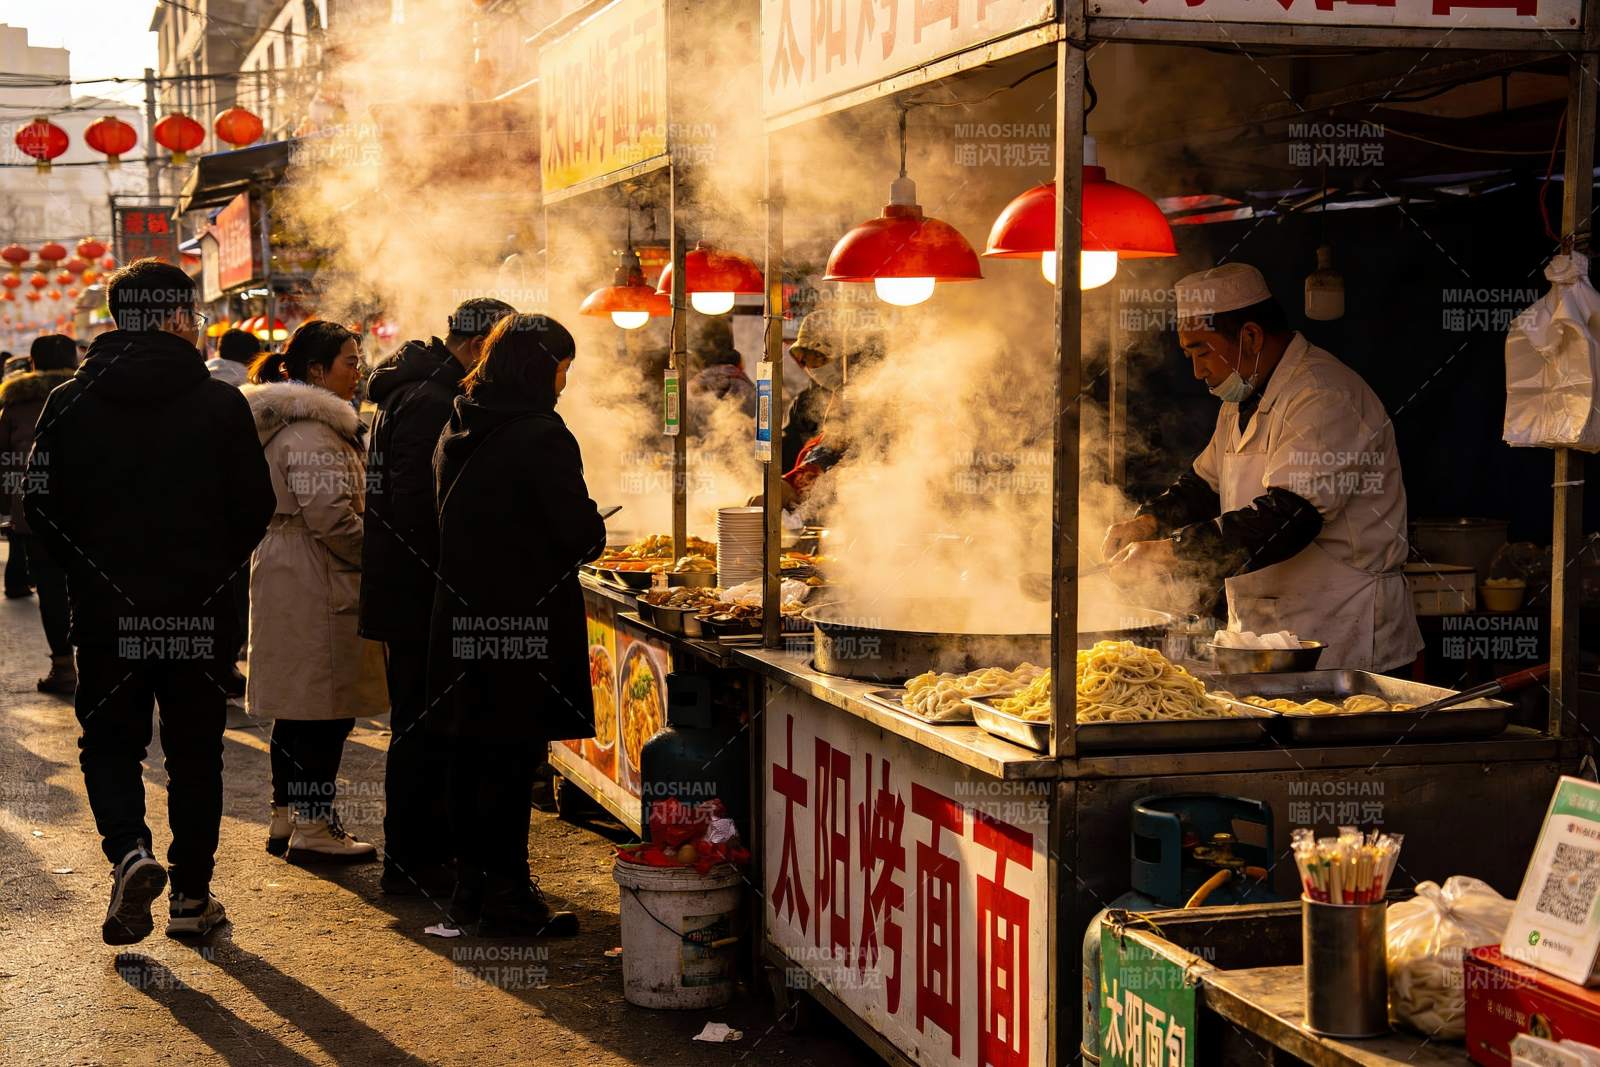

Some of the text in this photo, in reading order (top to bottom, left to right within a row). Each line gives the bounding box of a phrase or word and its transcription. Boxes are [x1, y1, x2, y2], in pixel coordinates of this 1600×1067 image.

[771, 713, 1034, 1067] 太阳烤面面
